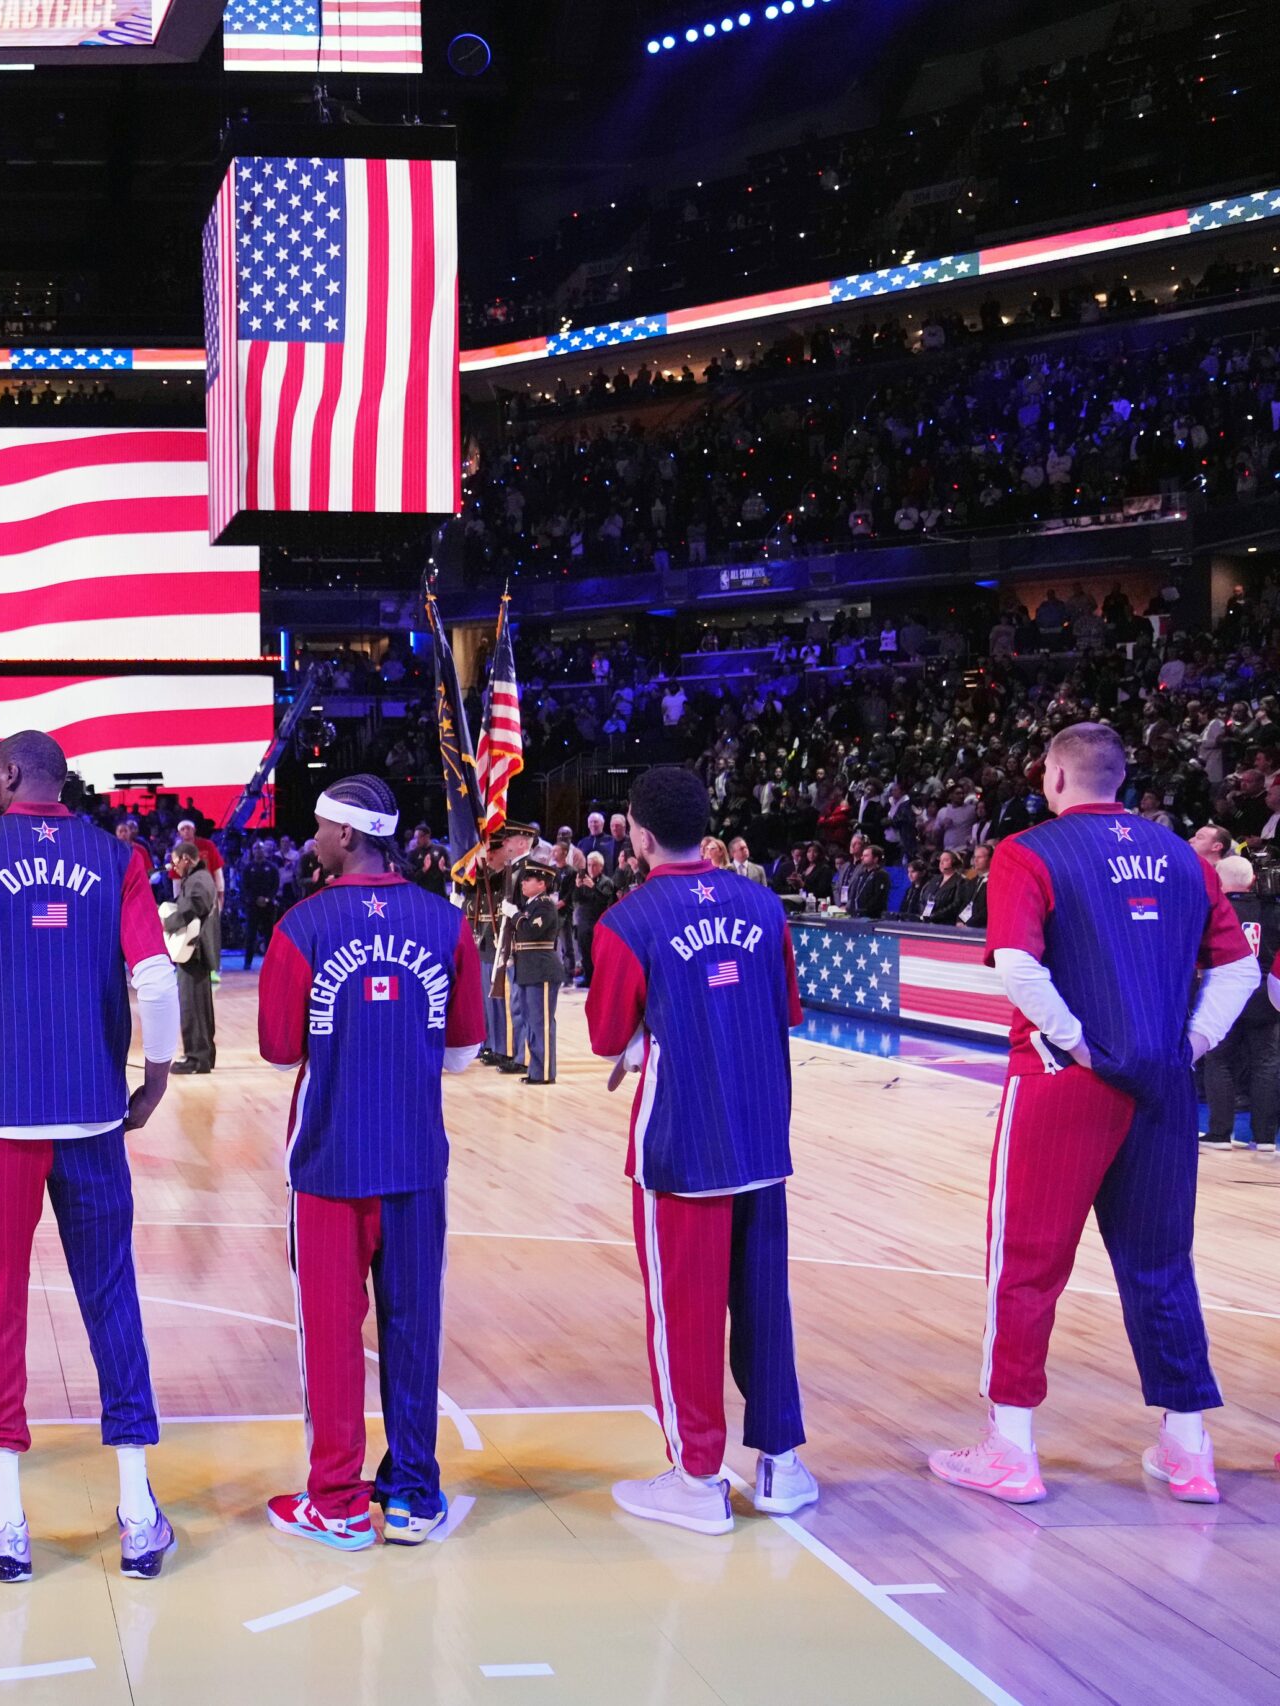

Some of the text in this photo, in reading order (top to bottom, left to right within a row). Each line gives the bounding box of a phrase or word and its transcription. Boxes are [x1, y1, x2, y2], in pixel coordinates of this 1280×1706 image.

[1107, 855, 1168, 884] JOKIĆ
[669, 917, 763, 961] BOOKER
[309, 934, 449, 1035] GILGEOUS-ALEXANDER
